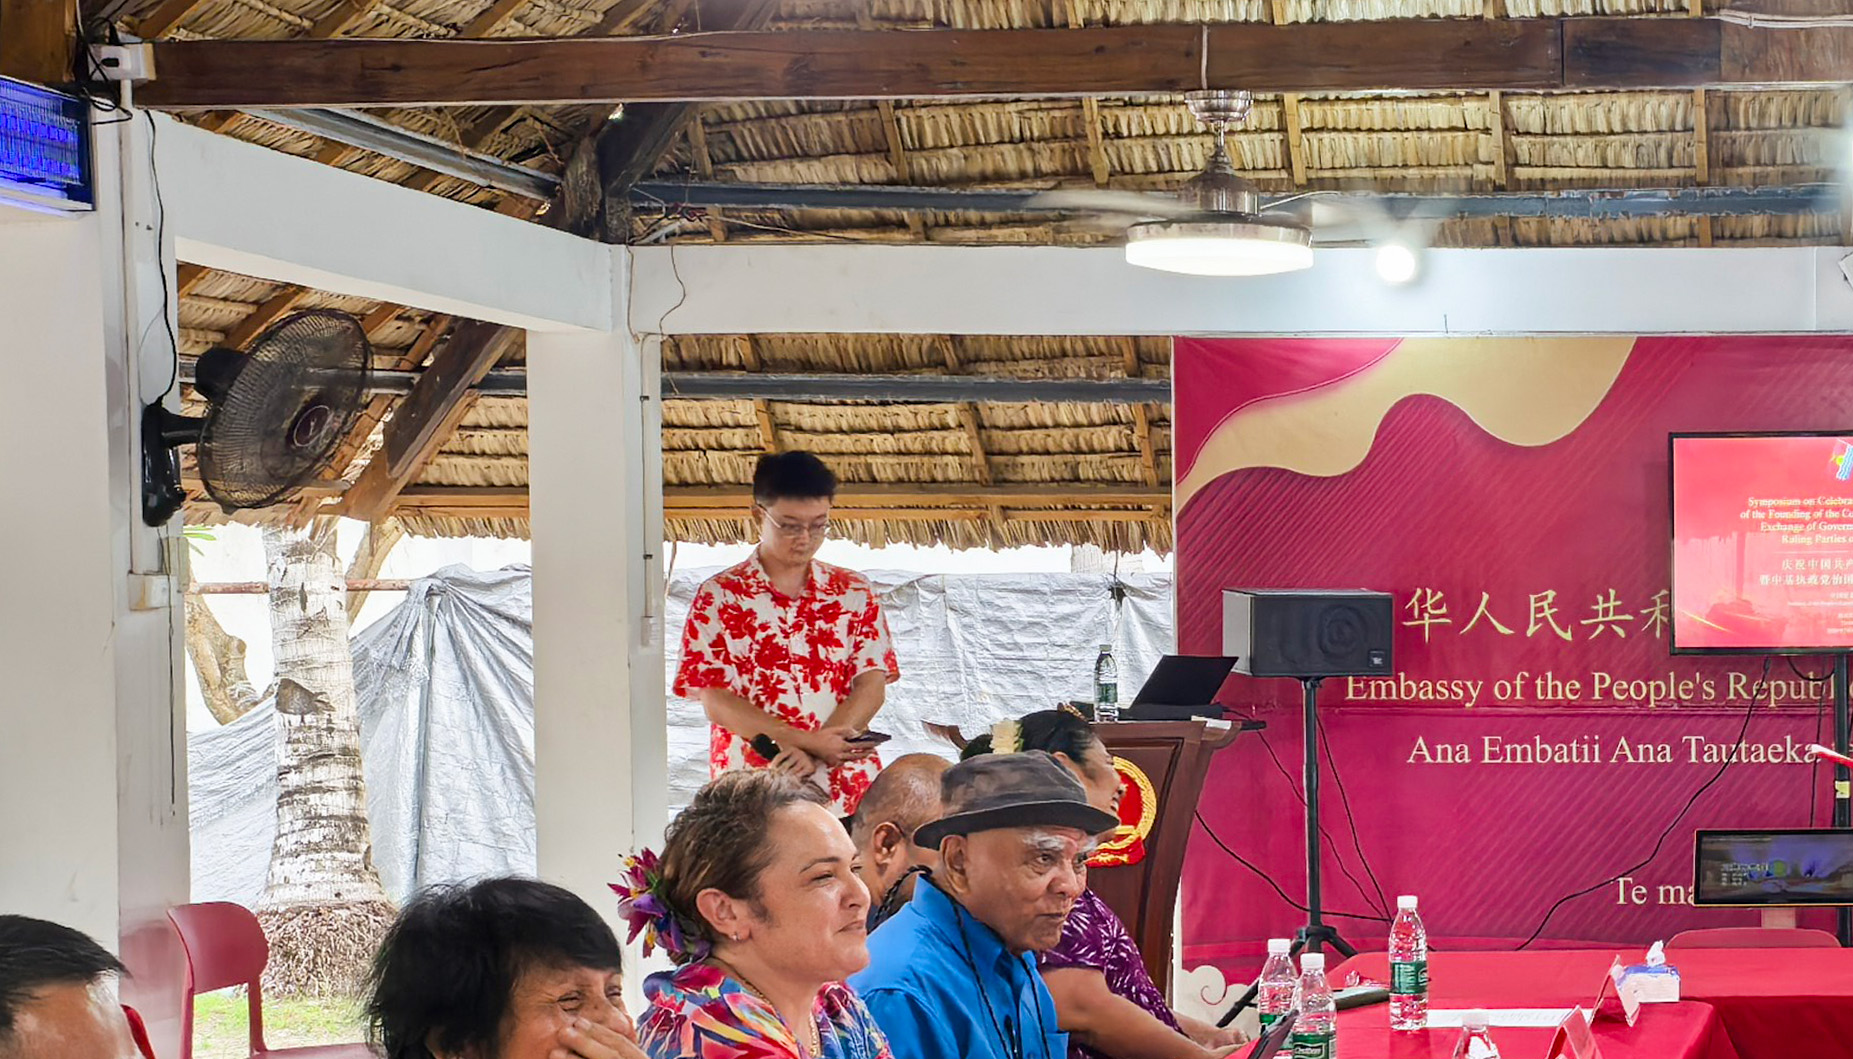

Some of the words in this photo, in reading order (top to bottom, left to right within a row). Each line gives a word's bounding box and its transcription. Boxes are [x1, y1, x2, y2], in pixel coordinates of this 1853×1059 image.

[1748, 497, 1800, 508] Symposium
[1740, 509, 1750, 519] of
[1752, 509, 1766, 519] the
[1768, 509, 1811, 520] Founding
[1813, 509, 1824, 518] of
[1825, 509, 1840, 518] the
[1760, 521, 1804, 533] Exchange
[1806, 521, 1817, 531] of
[1782, 534, 1813, 545] Ruling
[1815, 534, 1847, 543] Parties
[1346, 672, 1483, 707] Embassy
[1494, 671, 1529, 699] of
[1536, 671, 1581, 699] the
[1591, 671, 1716, 708] People's
[1407, 736, 1472, 763] Ana
[1481, 734, 1601, 763] Embatii
[1610, 736, 1674, 763] Ana
[1616, 877, 1648, 905] Te
